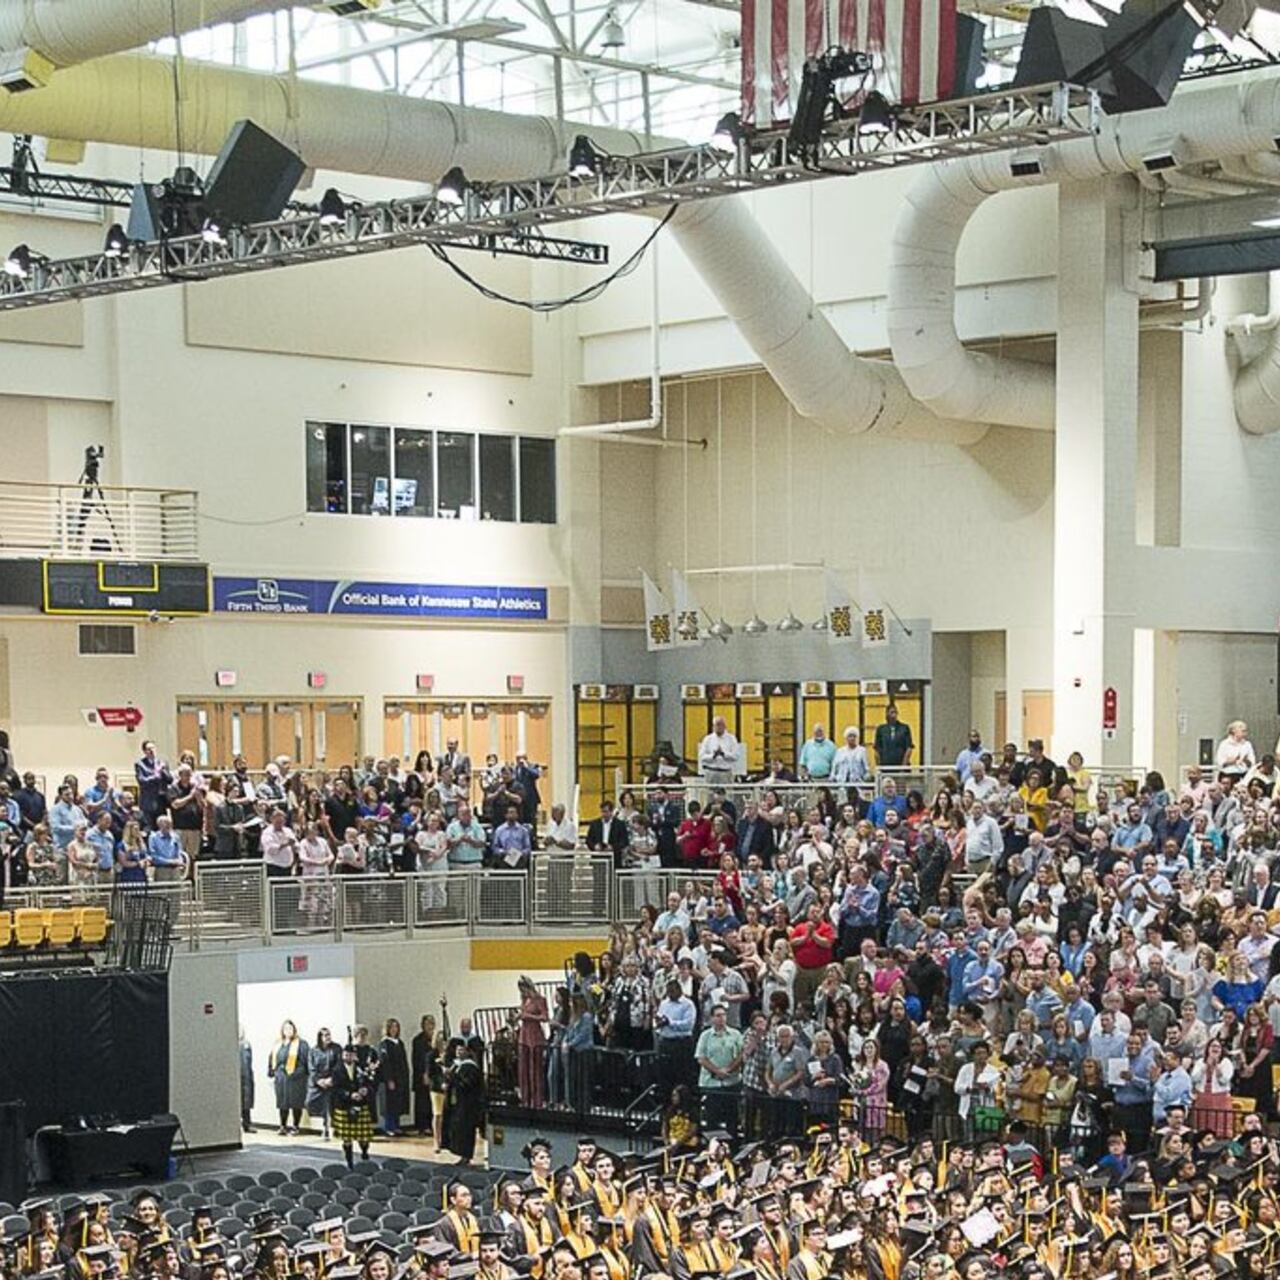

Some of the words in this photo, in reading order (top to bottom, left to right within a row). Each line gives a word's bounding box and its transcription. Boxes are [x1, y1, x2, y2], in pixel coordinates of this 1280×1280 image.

[381, 594, 407, 607] Bank
[408, 595, 420, 607] of
[472, 596, 498, 609] State
[499, 597, 541, 611] Athletics
